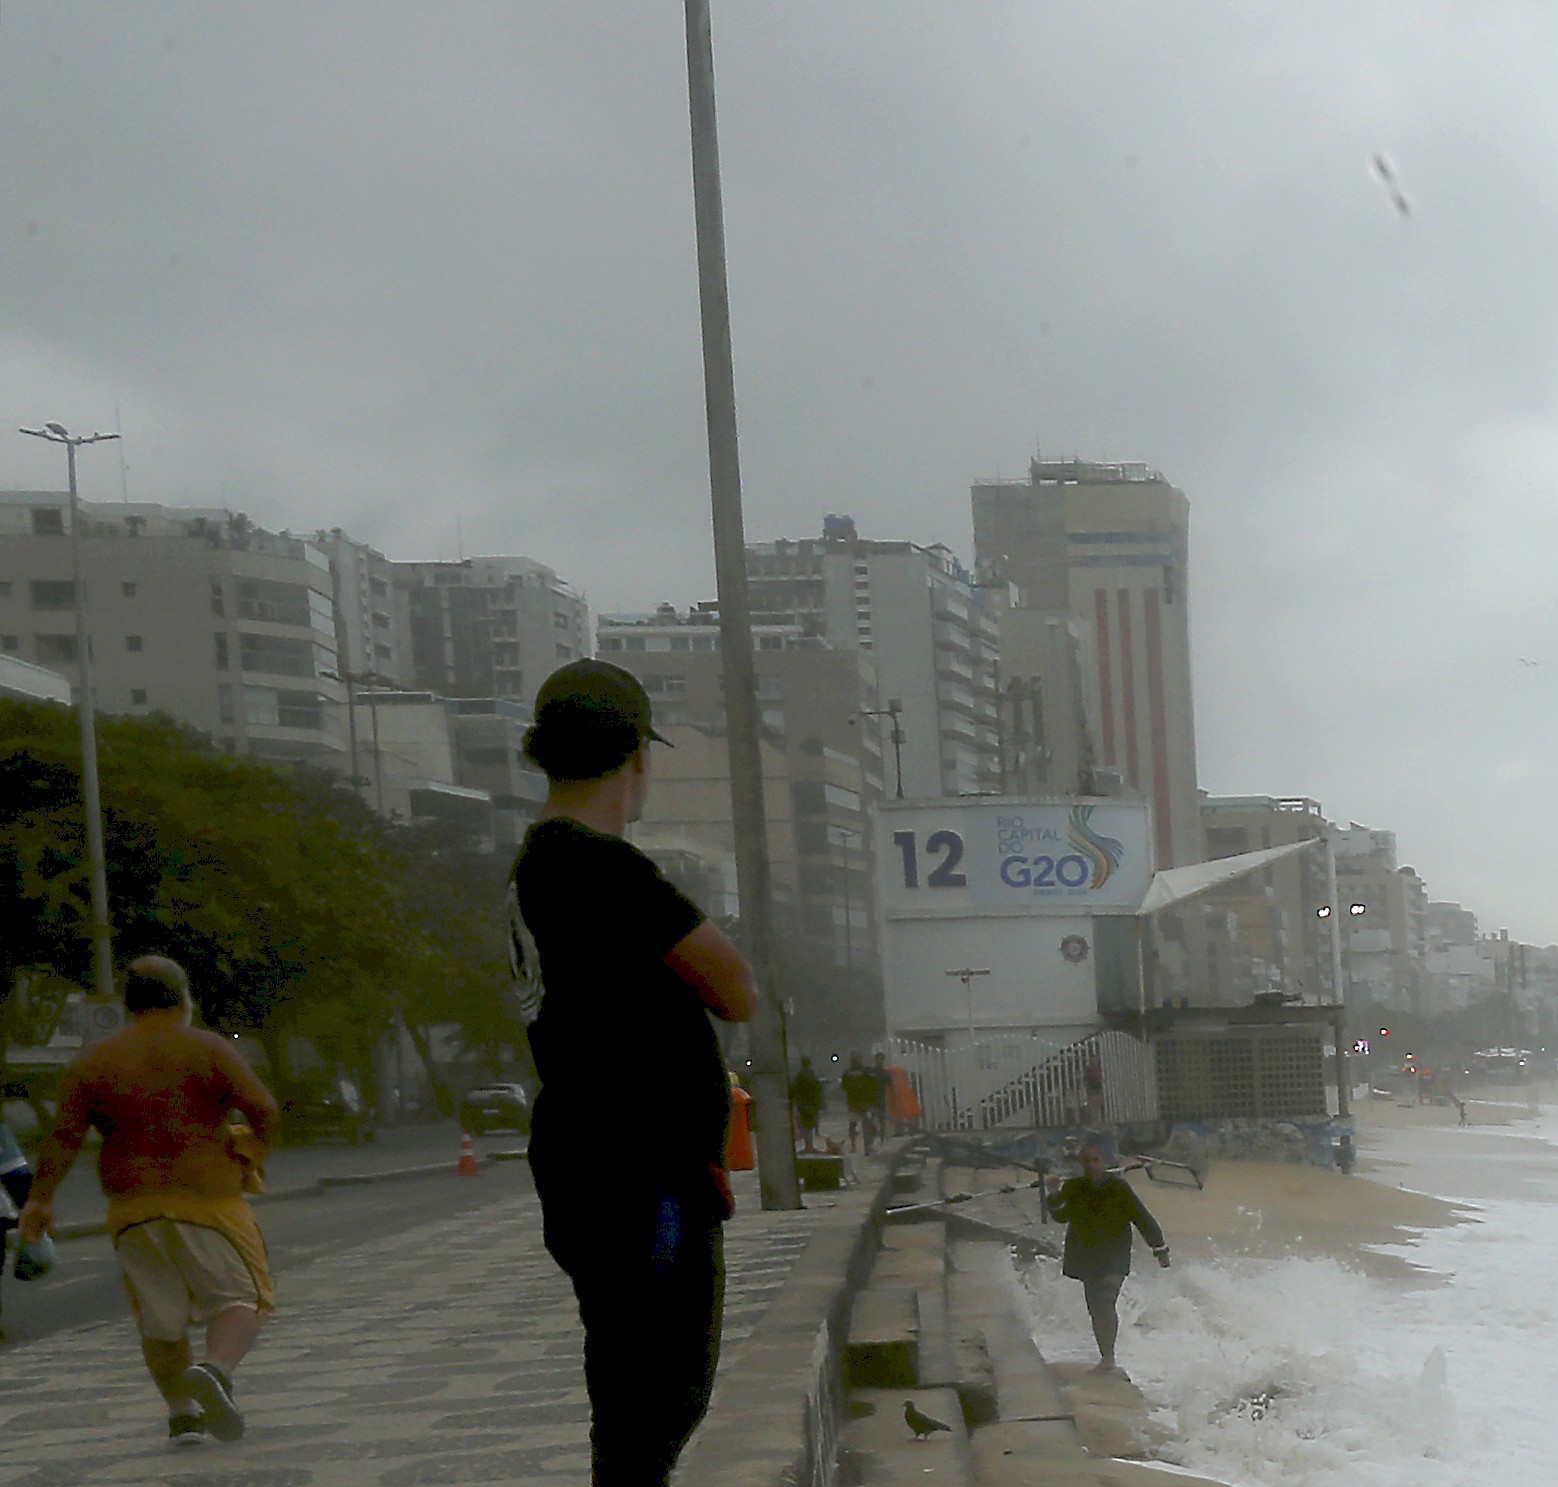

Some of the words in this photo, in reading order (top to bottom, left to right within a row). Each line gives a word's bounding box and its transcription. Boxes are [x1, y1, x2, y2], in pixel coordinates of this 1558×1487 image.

[997, 816, 1024, 829] RIO
[997, 828, 1062, 842] CAPITAL
[998, 841, 1024, 854] DO
[893, 829, 967, 888] 12
[1000, 854, 1090, 888] G20
